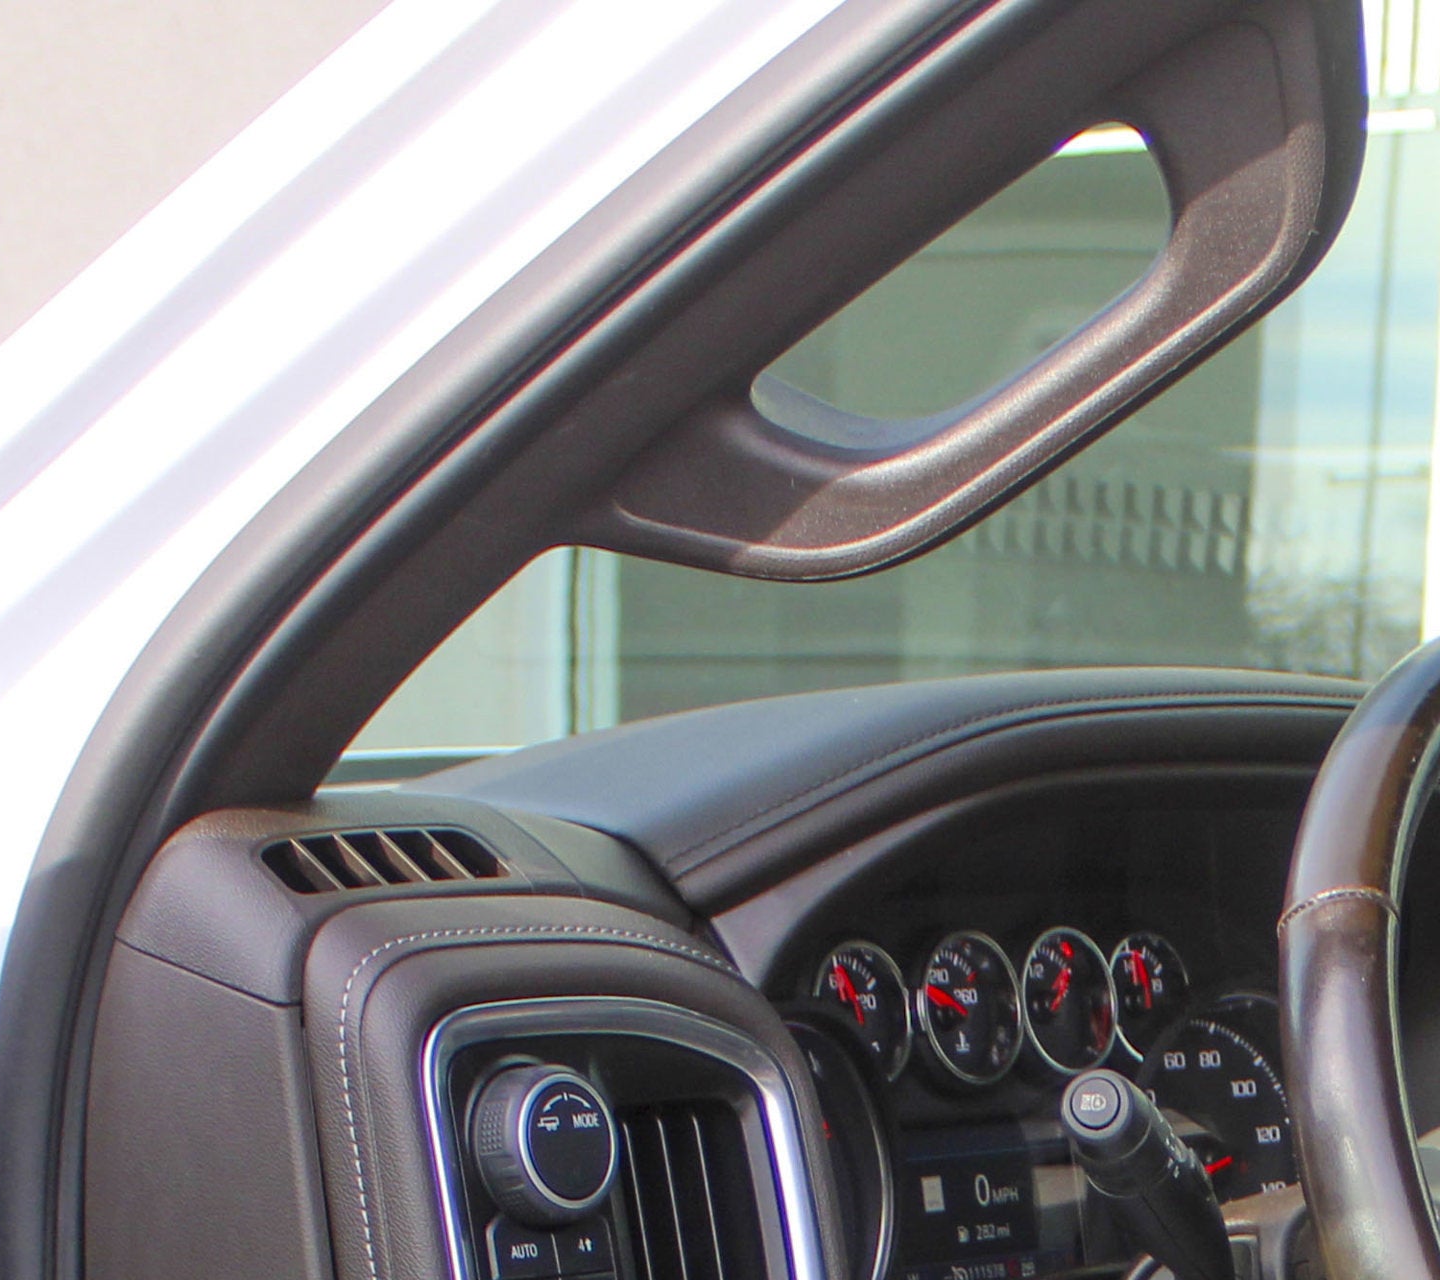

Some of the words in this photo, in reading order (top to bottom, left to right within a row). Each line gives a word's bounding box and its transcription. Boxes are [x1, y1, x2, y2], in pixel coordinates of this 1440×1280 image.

[1163, 1051, 1186, 1069] 60
[1198, 1050, 1221, 1069] 80
[1230, 1080, 1258, 1098] 100
[572, 1112, 599, 1130] MODE
[1256, 1126, 1281, 1144] 120
[975, 1174, 990, 1206] 0
[993, 1188, 1019, 1204] MPH
[511, 1242, 538, 1260] AUTO
